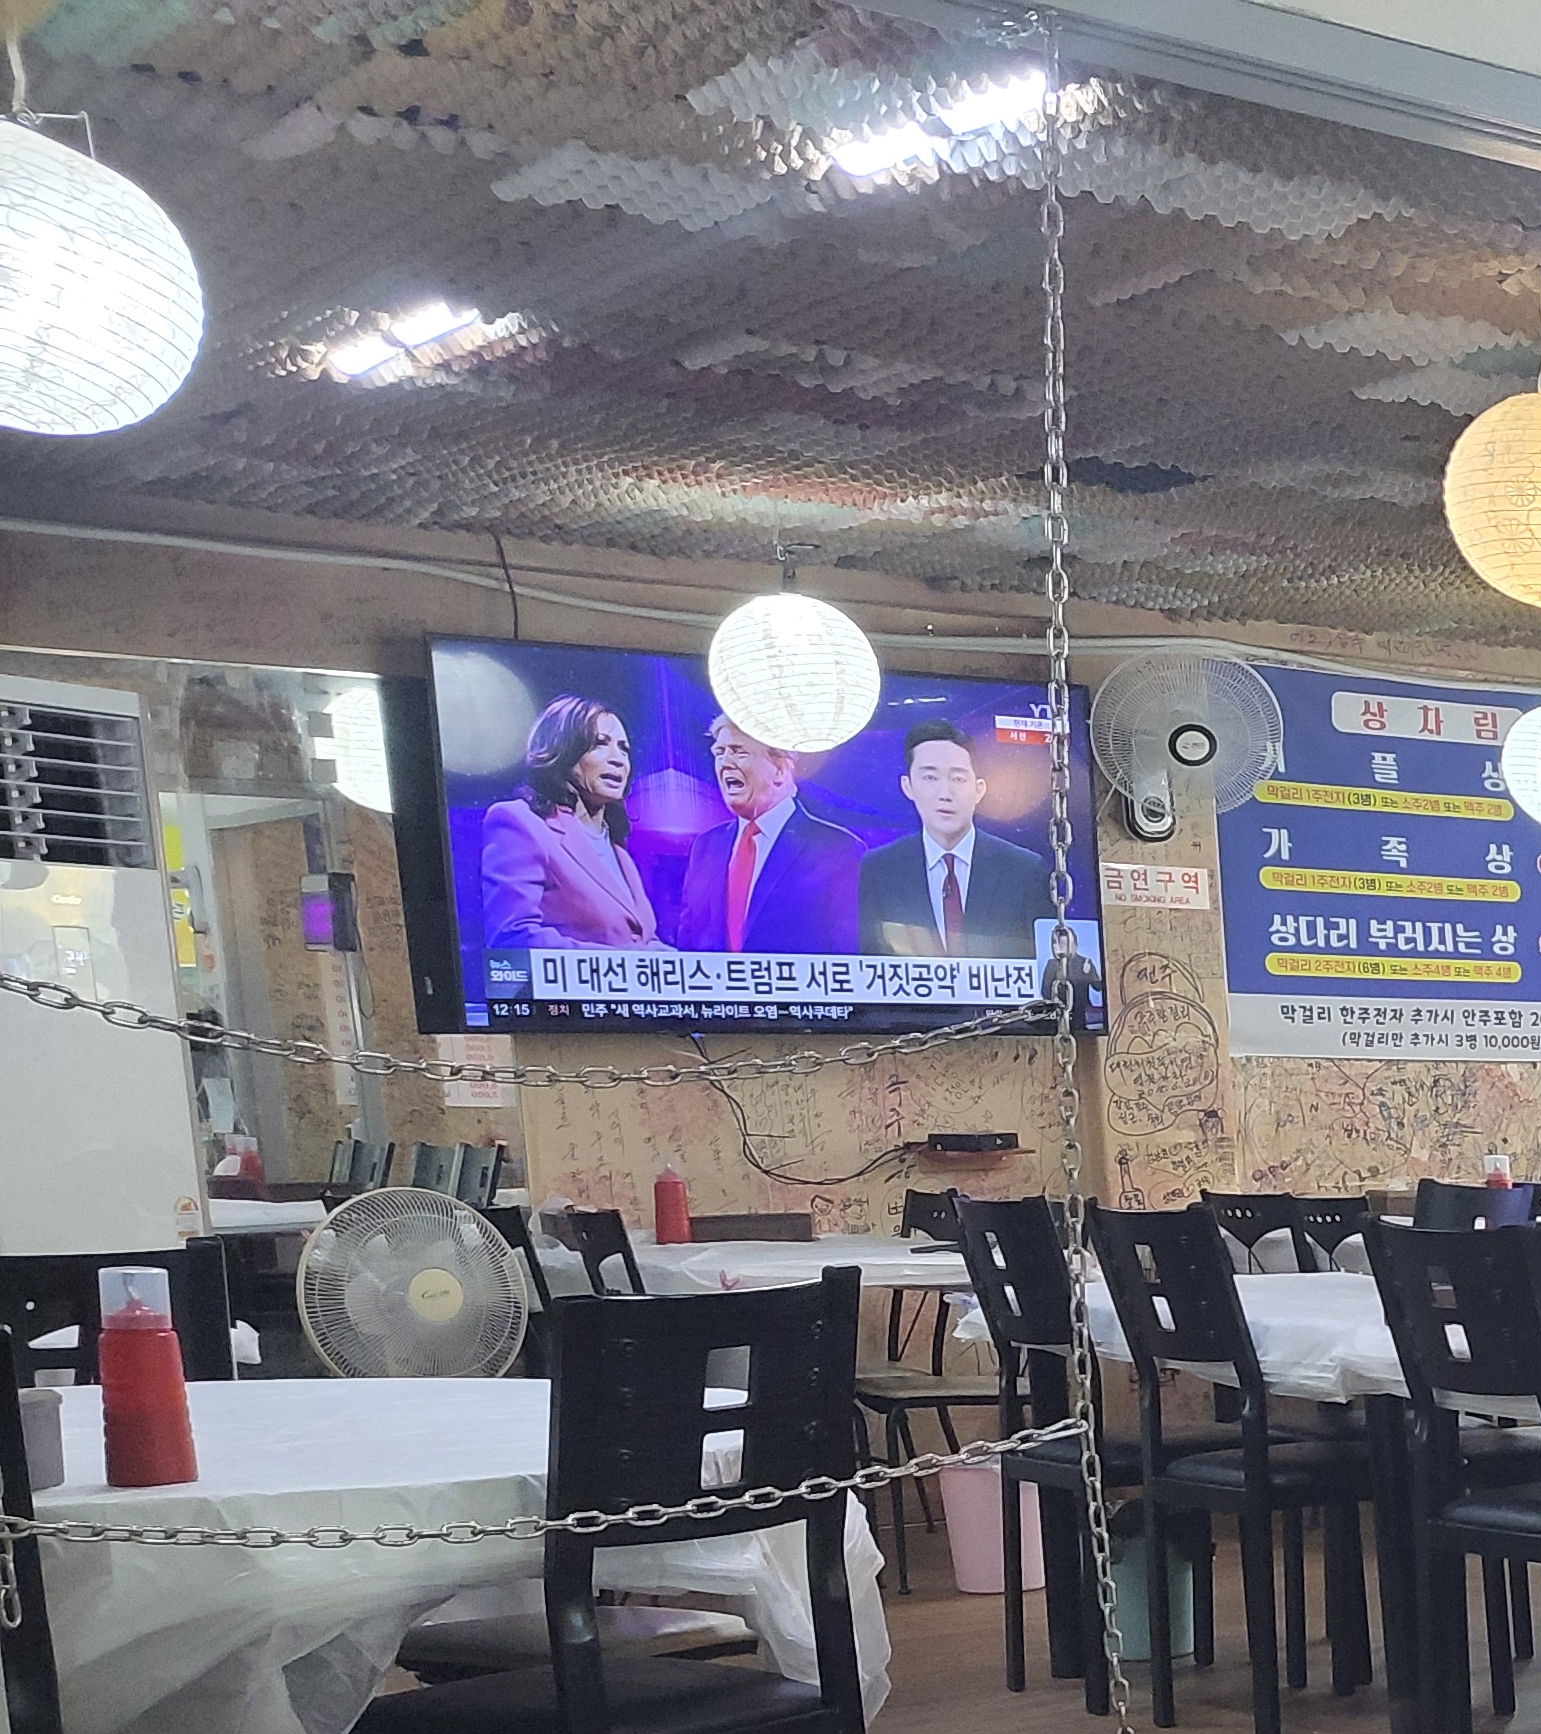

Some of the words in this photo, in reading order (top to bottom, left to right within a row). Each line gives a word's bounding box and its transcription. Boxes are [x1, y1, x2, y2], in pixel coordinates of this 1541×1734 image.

[1266, 785, 1304, 802] 막걸리
[1381, 797, 1399, 809] 또는
[1443, 801, 1462, 814] 또는
[1463, 802, 1485, 816] 맥주
[1104, 867, 1200, 895] 금연구역
[1272, 872, 1308, 887] 막걸리
[1386, 881, 1404, 893] 또는
[1406, 881, 1445, 895] 소주2병
[1447, 884, 1464, 896] 또는
[1466, 884, 1489, 897] 맥주
[1491, 885, 1510, 899] 2병
[1115, 893, 1127, 902] NO
[1170, 896, 1191, 905] AREA
[1268, 914, 1358, 950] 상다리
[1368, 919, 1483, 955] 부러지는
[1490, 925, 1518, 956] 상
[489, 959, 511, 970] 뉴스
[489, 969, 530, 982] 와이드
[1276, 957, 1312, 973] 막걸리
[1390, 965, 1409, 976] 또는
[1411, 964, 1451, 978] 소주4병
[1454, 966, 1471, 978] 또는
[1473, 965, 1494, 978] 맥주
[1495, 966, 1512, 981] 4병
[542, 957, 568, 993] 미
[577, 957, 630, 994] 대선
[635, 957, 800, 996] 해리스·트럼프
[805, 960, 855, 996] 서로
[858, 959, 961, 999] '거짓공약'
[968, 964, 1036, 999] 비난전
[492, 1004, 531, 1016] 12:15
[582, 1005, 608, 1018] 민주
[632, 1004, 699, 1019] 역사교과서,
[701, 1005, 752, 1019] 뉴라이트
[1280, 1004, 1332, 1025] 막걸리
[1339, 1006, 1404, 1026] 한주전자
[1409, 1008, 1456, 1026] 추가시
[1461, 1008, 1524, 1029] 안주포함
[1341, 1031, 1404, 1048] (막걸리만
[1409, 1032, 1450, 1048] 추가시
[1454, 1033, 1479, 1050] 3병
